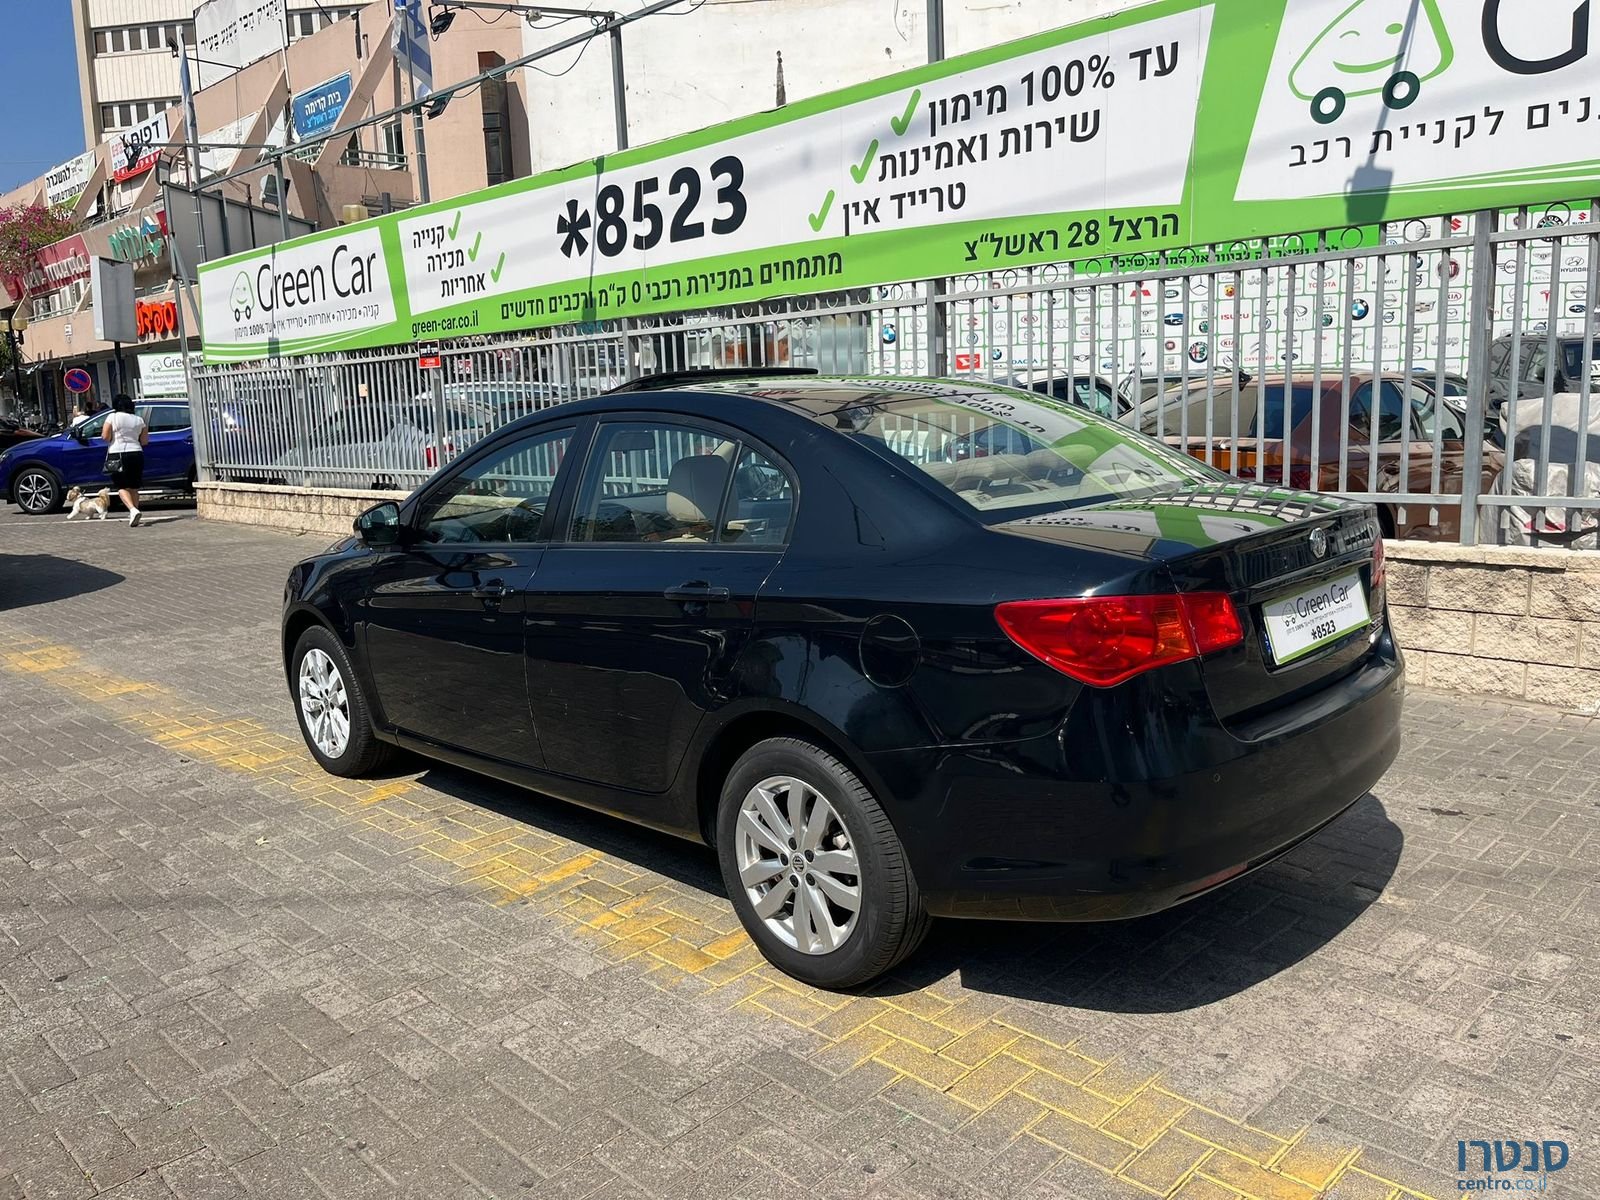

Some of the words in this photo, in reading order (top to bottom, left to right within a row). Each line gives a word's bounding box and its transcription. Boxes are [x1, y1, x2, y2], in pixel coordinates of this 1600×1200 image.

[1129, 41, 1179, 82] עד
[1019, 53, 1116, 108] 100%
[928, 81, 1008, 138] מימון
[998, 108, 1101, 158] שירות
[1369, 105, 1504, 155] לקניית
[878, 132, 988, 183] ואמינות
[1289, 136, 1352, 168] רכב
[889, 181, 967, 220] טרייד
[842, 196, 881, 237] אין
[1108, 212, 1179, 243] הרצל
[413, 225, 445, 249] קנייה
[1067, 219, 1100, 249] 28
[428, 249, 464, 272] מכירה
[760, 252, 843, 285] מתמחים
[257, 263, 327, 312] Green
[331, 244, 376, 298] Car
[441, 272, 486, 298] אחריות
[632, 280, 641, 303] 0
[646, 278, 681, 301] רכבי
[686, 266, 754, 296] במכירת
[1309, 281, 1336, 289] TOOTA
[501, 298, 544, 320] חדשים
[549, 291, 593, 313] ורכבים
[412, 310, 479, 338] green-car.co.il
[1296, 593, 1331, 618] Green
[1330, 584, 1349, 605] Car
